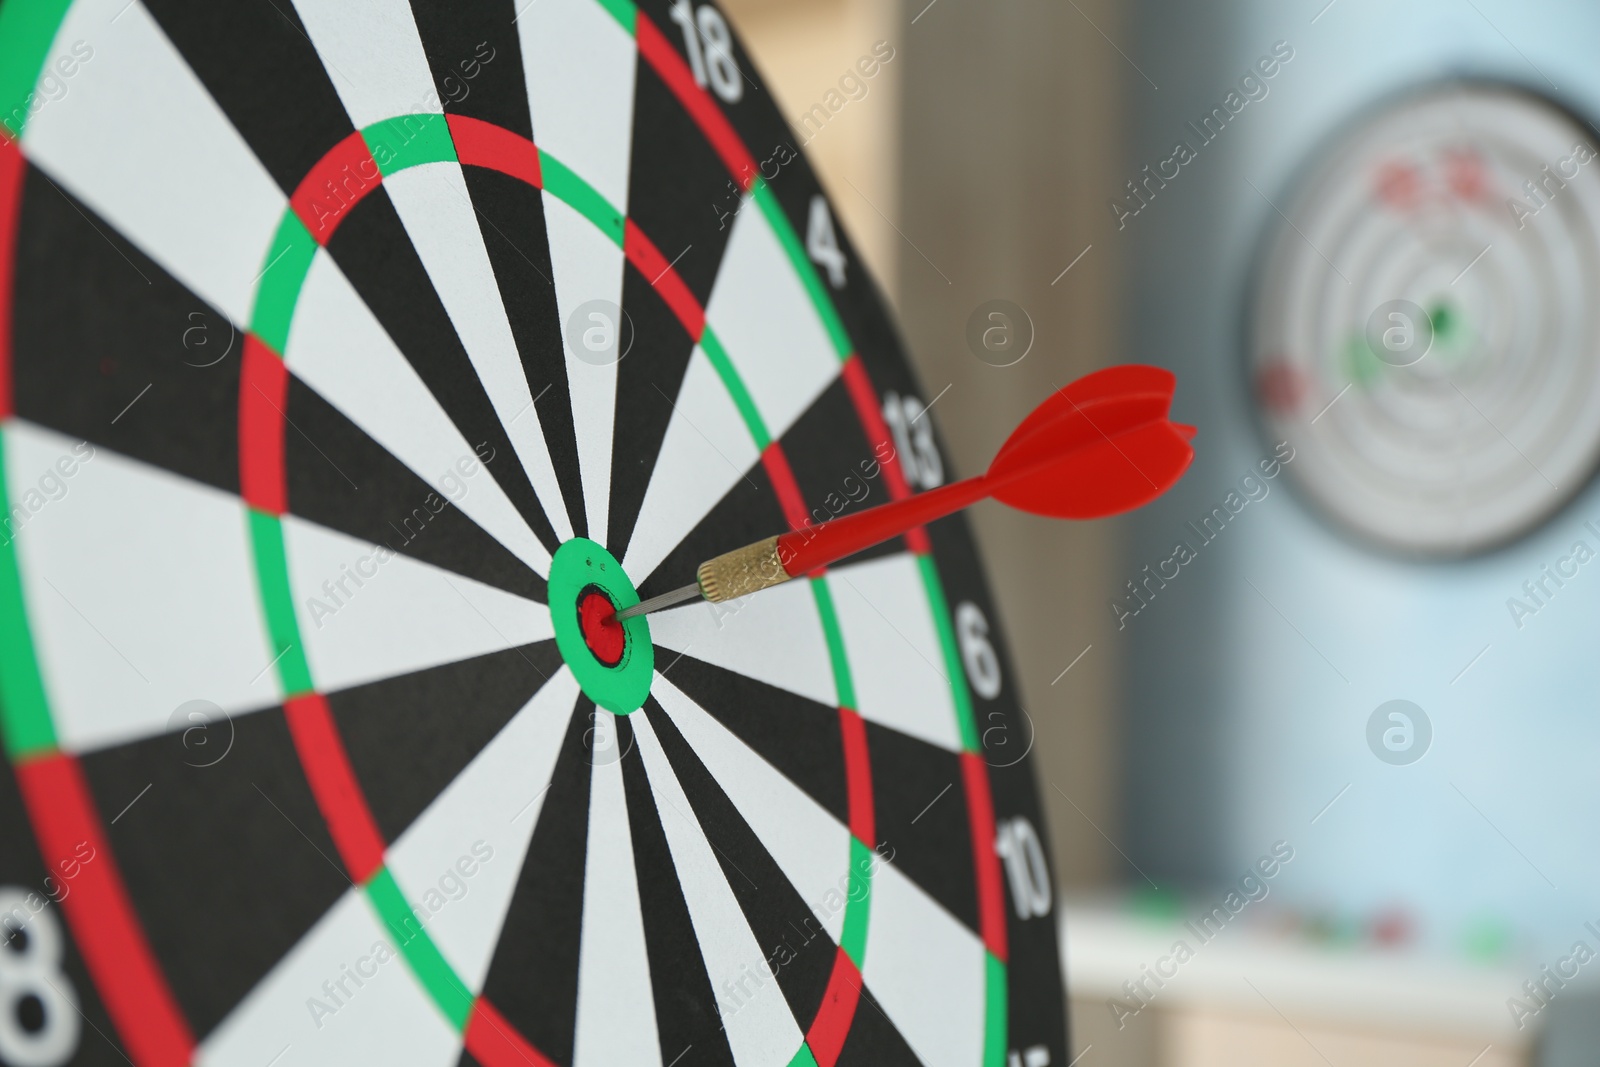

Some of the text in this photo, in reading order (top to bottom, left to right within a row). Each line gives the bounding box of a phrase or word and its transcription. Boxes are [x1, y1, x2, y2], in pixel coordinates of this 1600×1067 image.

[668, 0, 743, 103] 18
[805, 195, 848, 289] 4
[881, 389, 944, 490] 13
[955, 600, 1001, 700] 6
[994, 815, 1052, 920] 10
